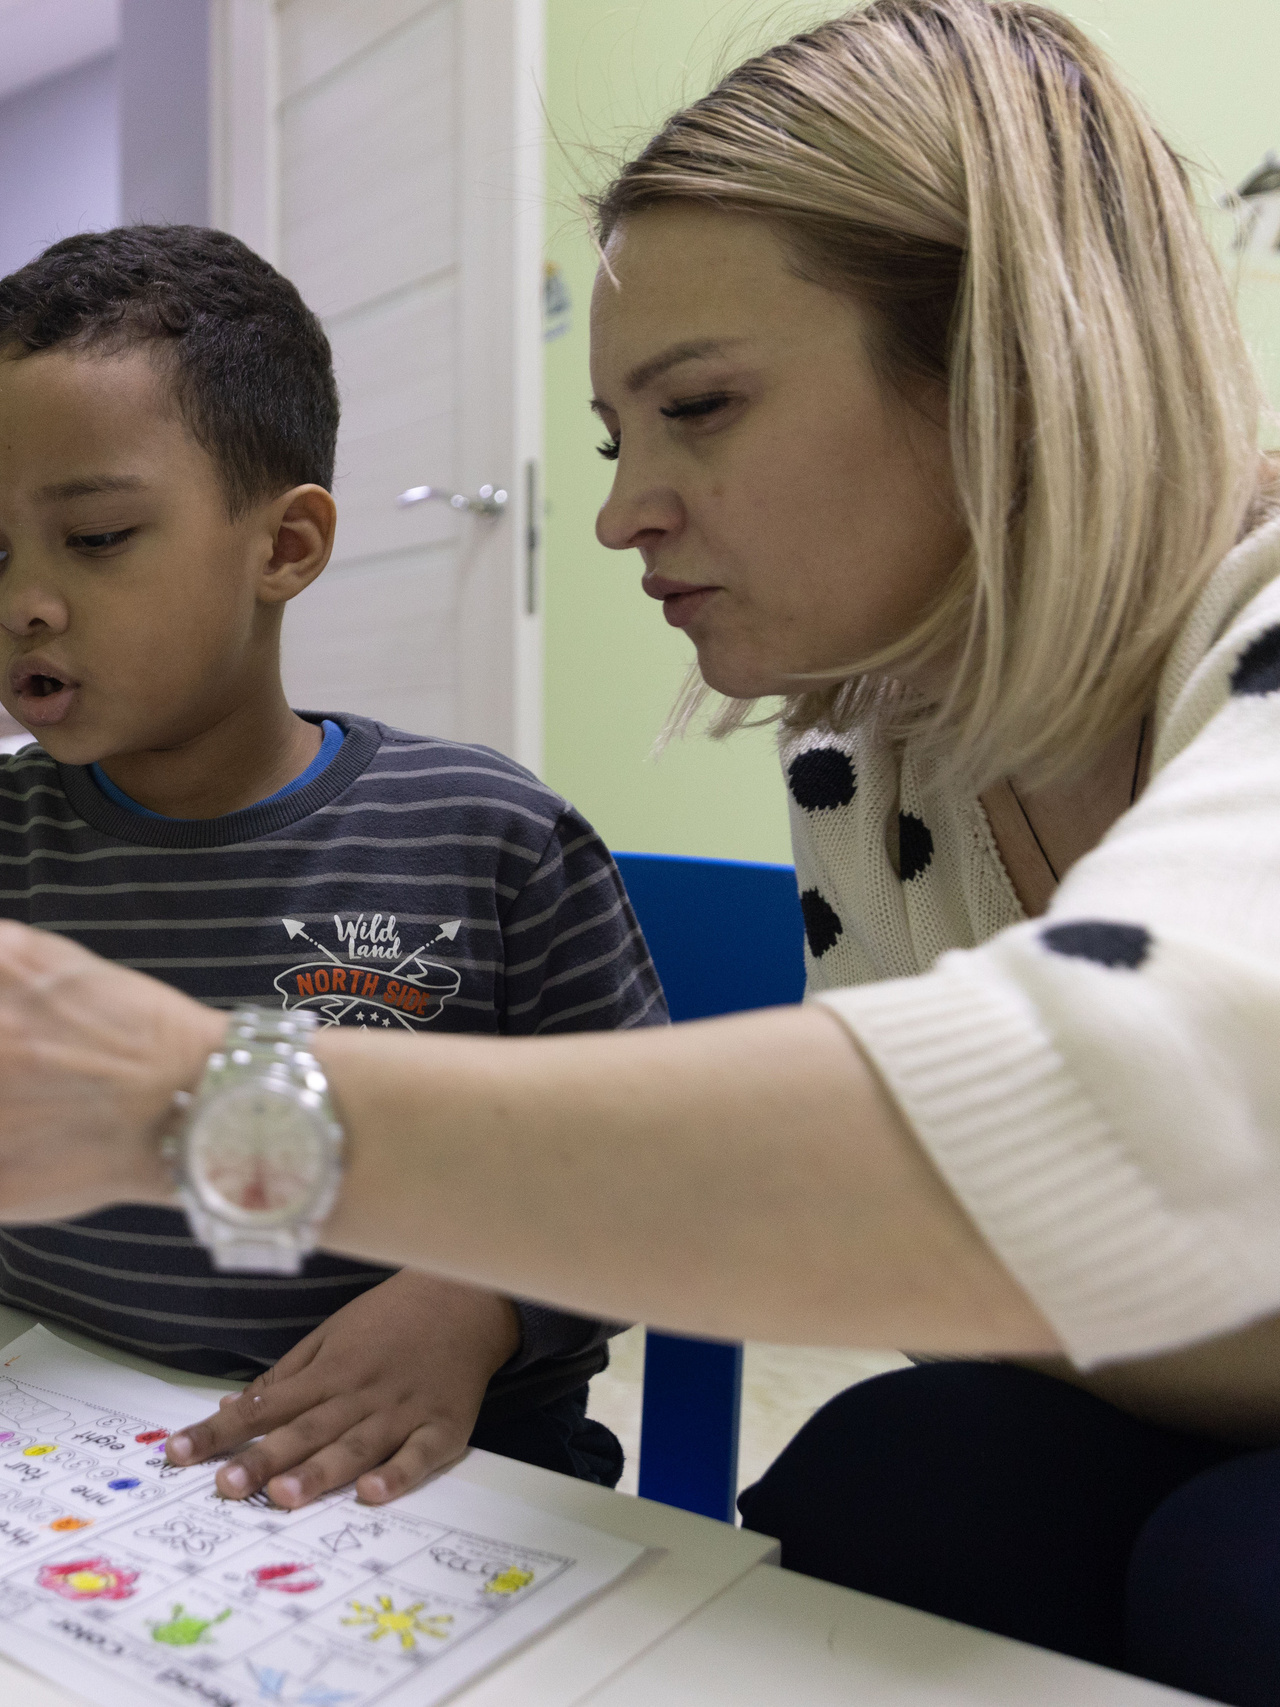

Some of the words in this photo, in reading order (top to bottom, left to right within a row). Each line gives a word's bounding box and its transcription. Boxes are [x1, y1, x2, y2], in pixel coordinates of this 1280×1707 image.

[334, 913, 399, 943] Wild
[348, 936, 402, 960] Land
[296, 969, 380, 997] NORTH
[383, 980, 430, 1016] SIDE
[70, 1430, 125, 1450] eight
[4, 1461, 49, 1482] four
[145, 1457, 185, 1479] five
[70, 1485, 115, 1506] nine
